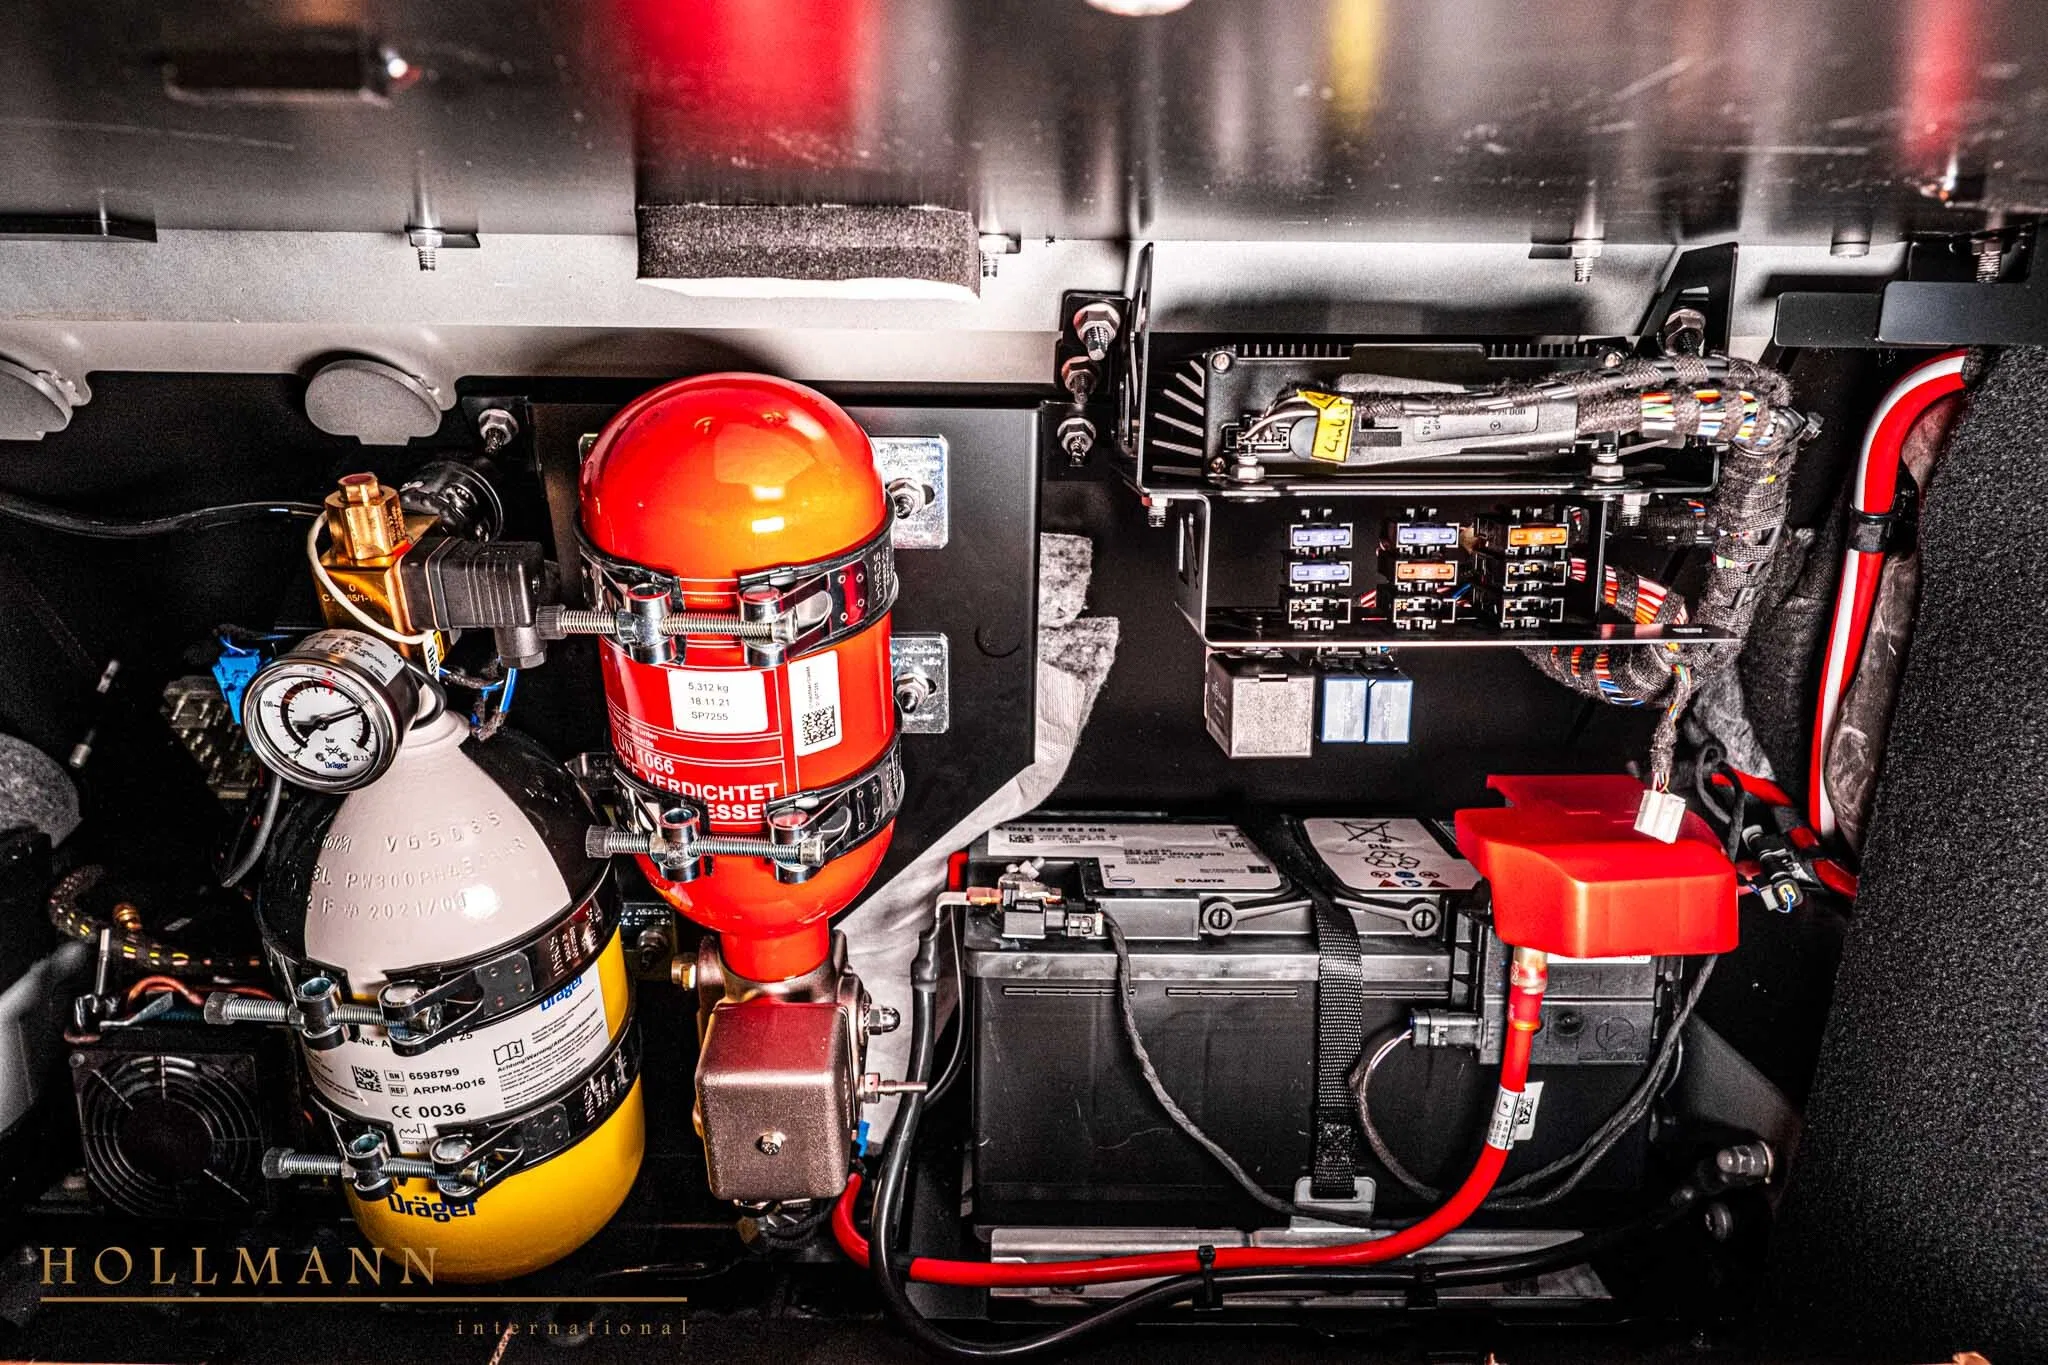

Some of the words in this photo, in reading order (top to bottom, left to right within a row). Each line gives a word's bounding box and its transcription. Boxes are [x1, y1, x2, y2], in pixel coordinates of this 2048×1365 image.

[617, 732, 634, 758] UN
[636, 749, 675, 775] 1066
[643, 768, 780, 802] VERDICHTET
[408, 1067, 461, 1081] 6598799
[413, 1077, 487, 1096] ARPM-0016
[418, 1102, 467, 1119] 0036
[387, 1192, 478, 1224] Dräger
